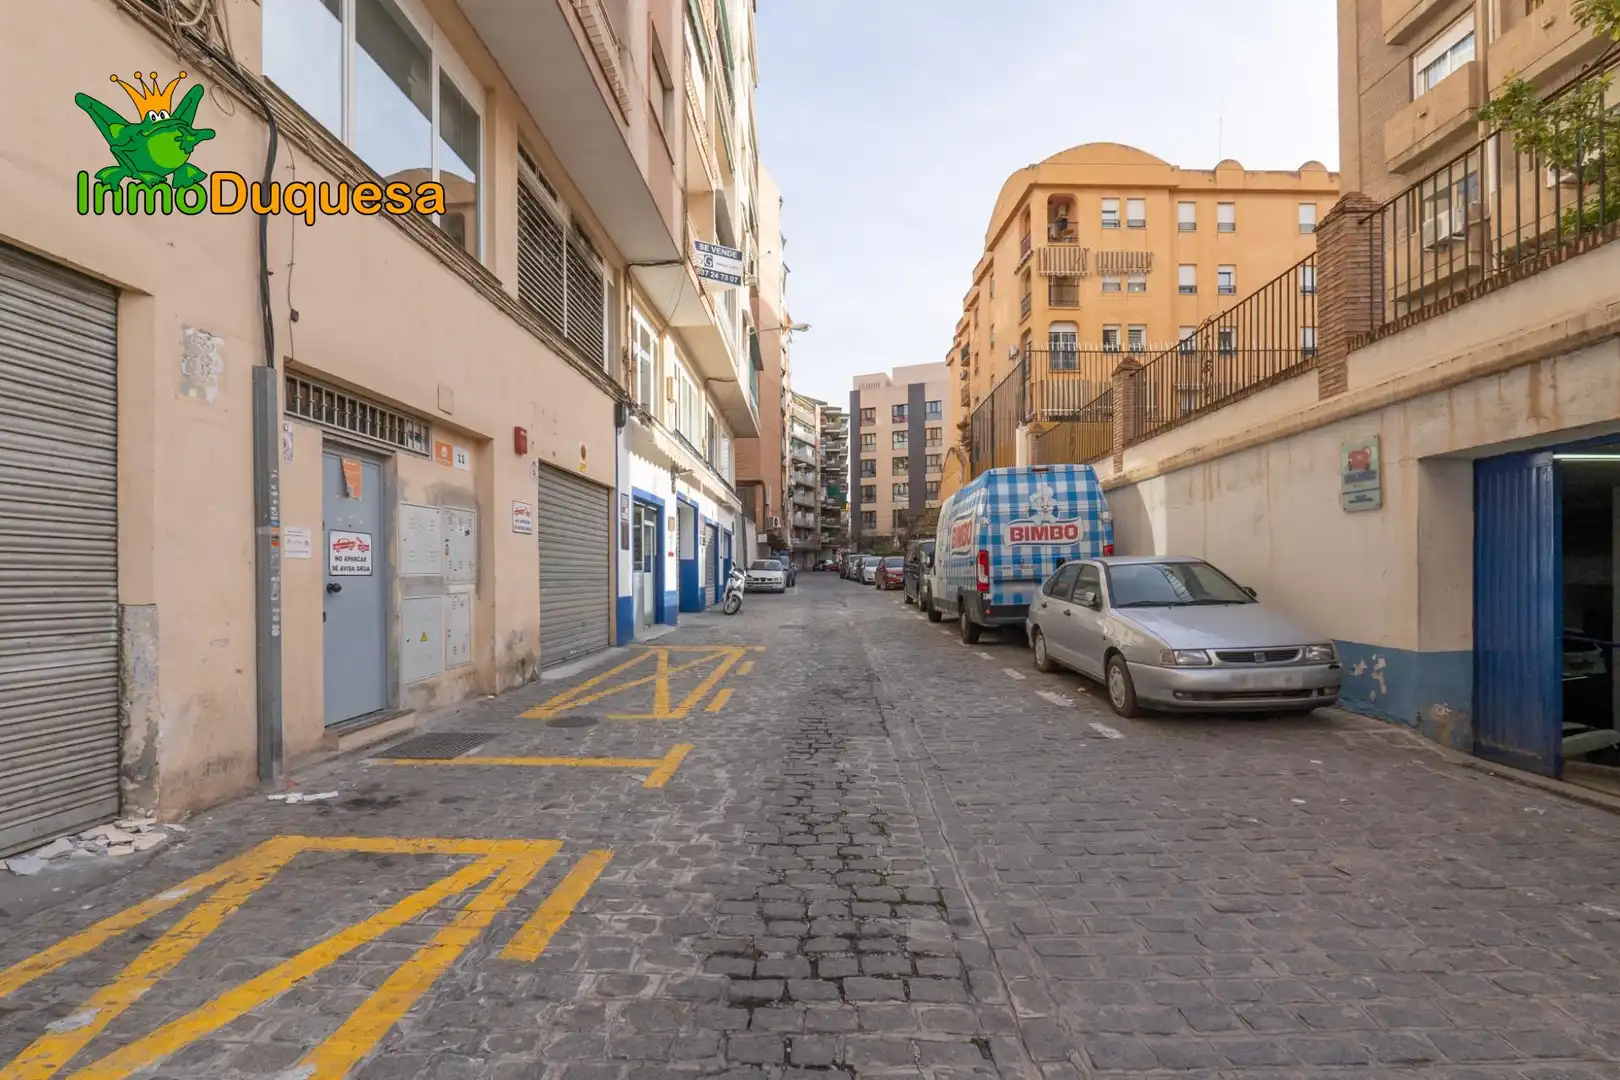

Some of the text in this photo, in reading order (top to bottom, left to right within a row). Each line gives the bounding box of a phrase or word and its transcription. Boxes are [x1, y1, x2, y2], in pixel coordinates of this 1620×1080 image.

[699, 243, 738, 259] SE VENDE
[710, 270, 719, 279] 24
[729, 276, 739, 284] 07
[457, 453, 464, 464] 11
[1009, 523, 1079, 542] BIMBO
